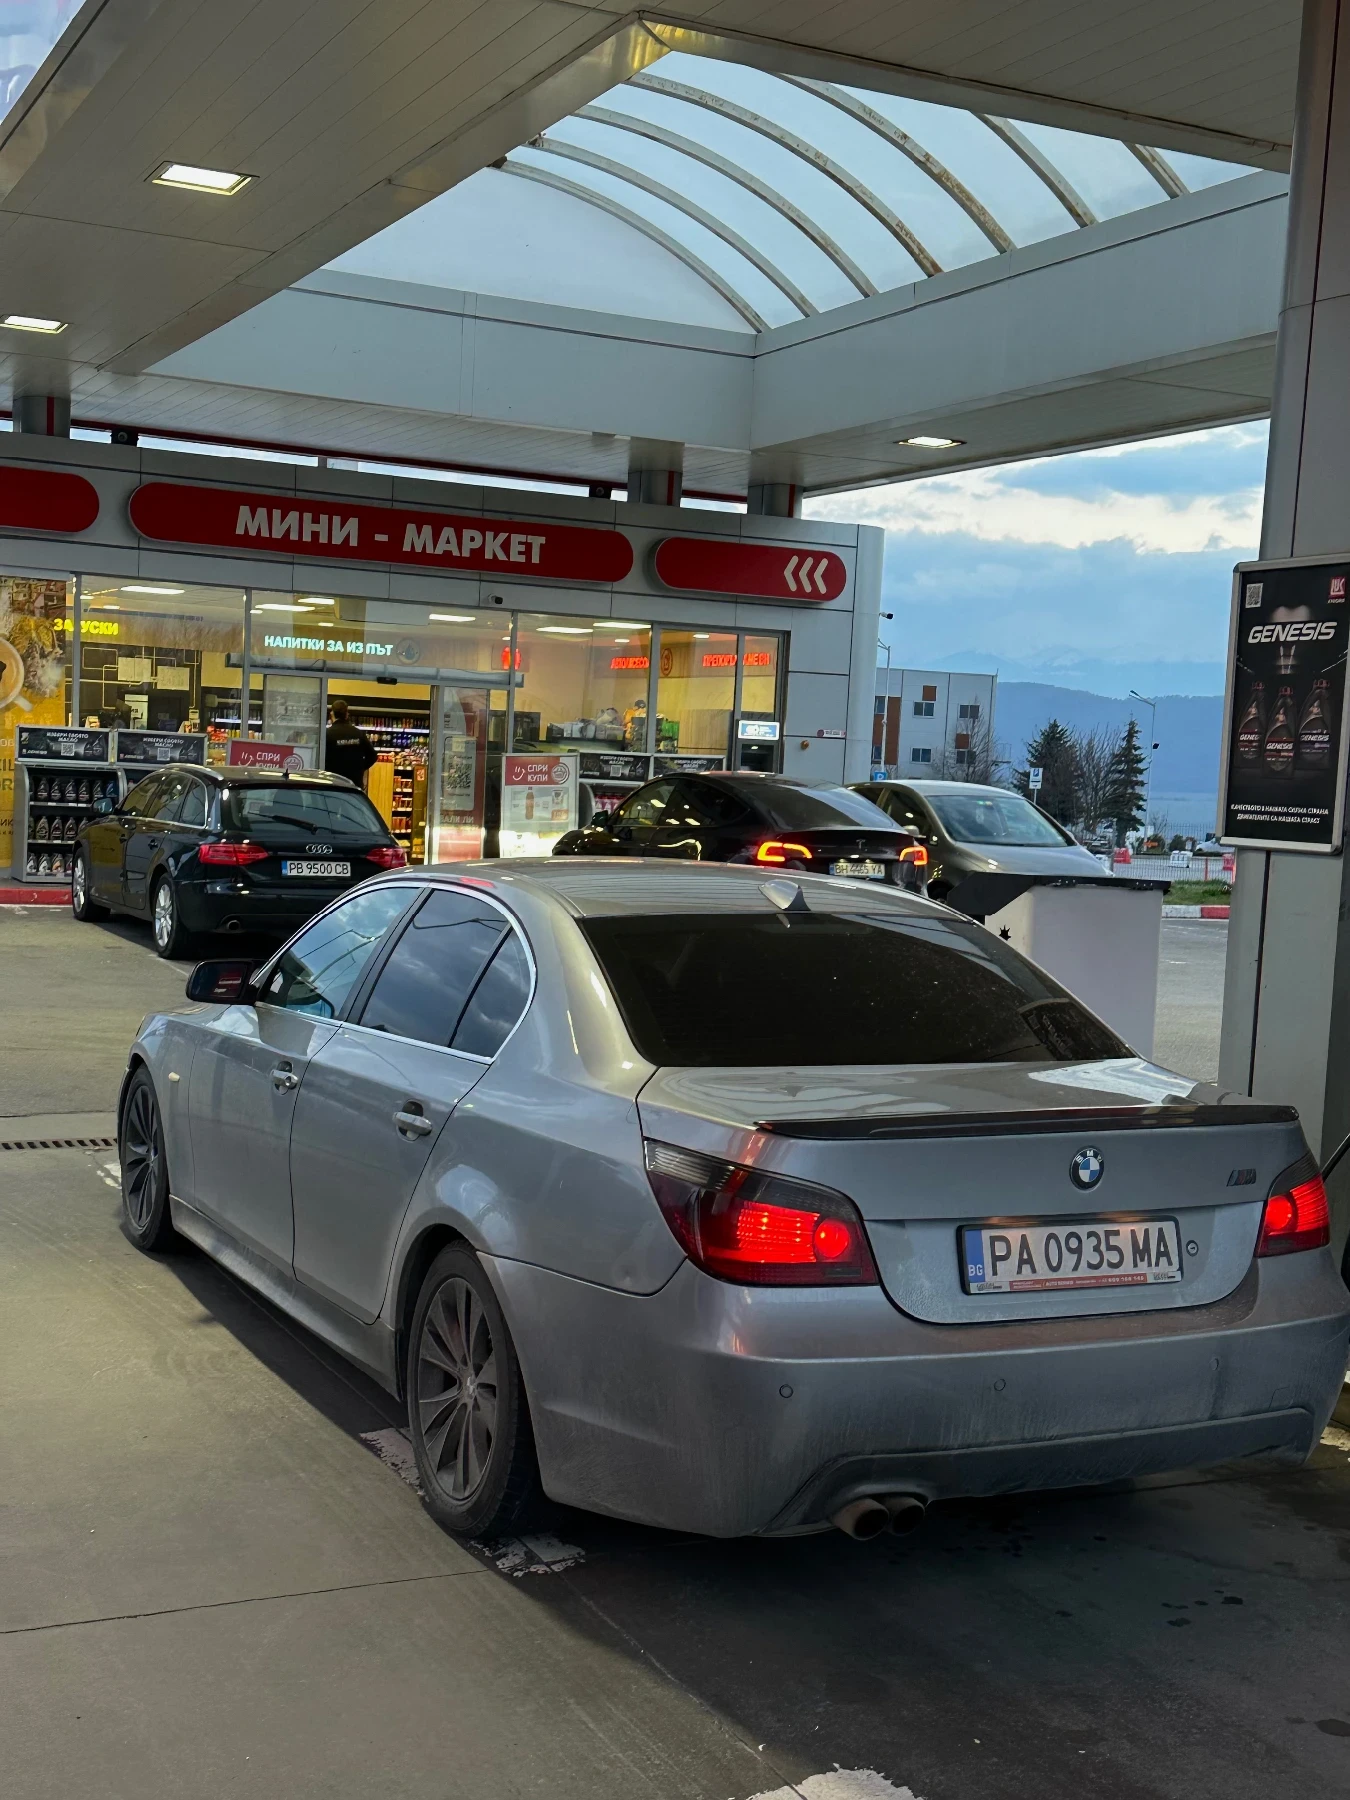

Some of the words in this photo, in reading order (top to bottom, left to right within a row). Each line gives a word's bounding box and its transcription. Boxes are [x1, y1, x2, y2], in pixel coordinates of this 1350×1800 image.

[235, 505, 359, 547] МИНИ
[402, 523, 546, 564] МАРКЕТ
[53, 618, 119, 636] ЗАУСКИ
[1248, 622, 1338, 644] GENESIS
[264, 635, 325, 651] НАПИТКИ
[326, 639, 345, 652] ЗА
[346, 641, 364, 654] ИЗ
[365, 643, 394, 656] ПЪТ
[256, 751, 281, 762] СПРИ
[527, 764, 549, 773] СПРИ
[527, 774, 549, 783] КУПИ
[289, 862, 304, 874] PB
[305, 863, 333, 875] 9500
[334, 863, 349, 875] CB
[1075, 1150, 1103, 1164] BMW
[989, 1233, 1037, 1277] PA
[1044, 1229, 1125, 1273] 0935
[1130, 1226, 1174, 1269] MA
[968, 1264, 984, 1277] BG
